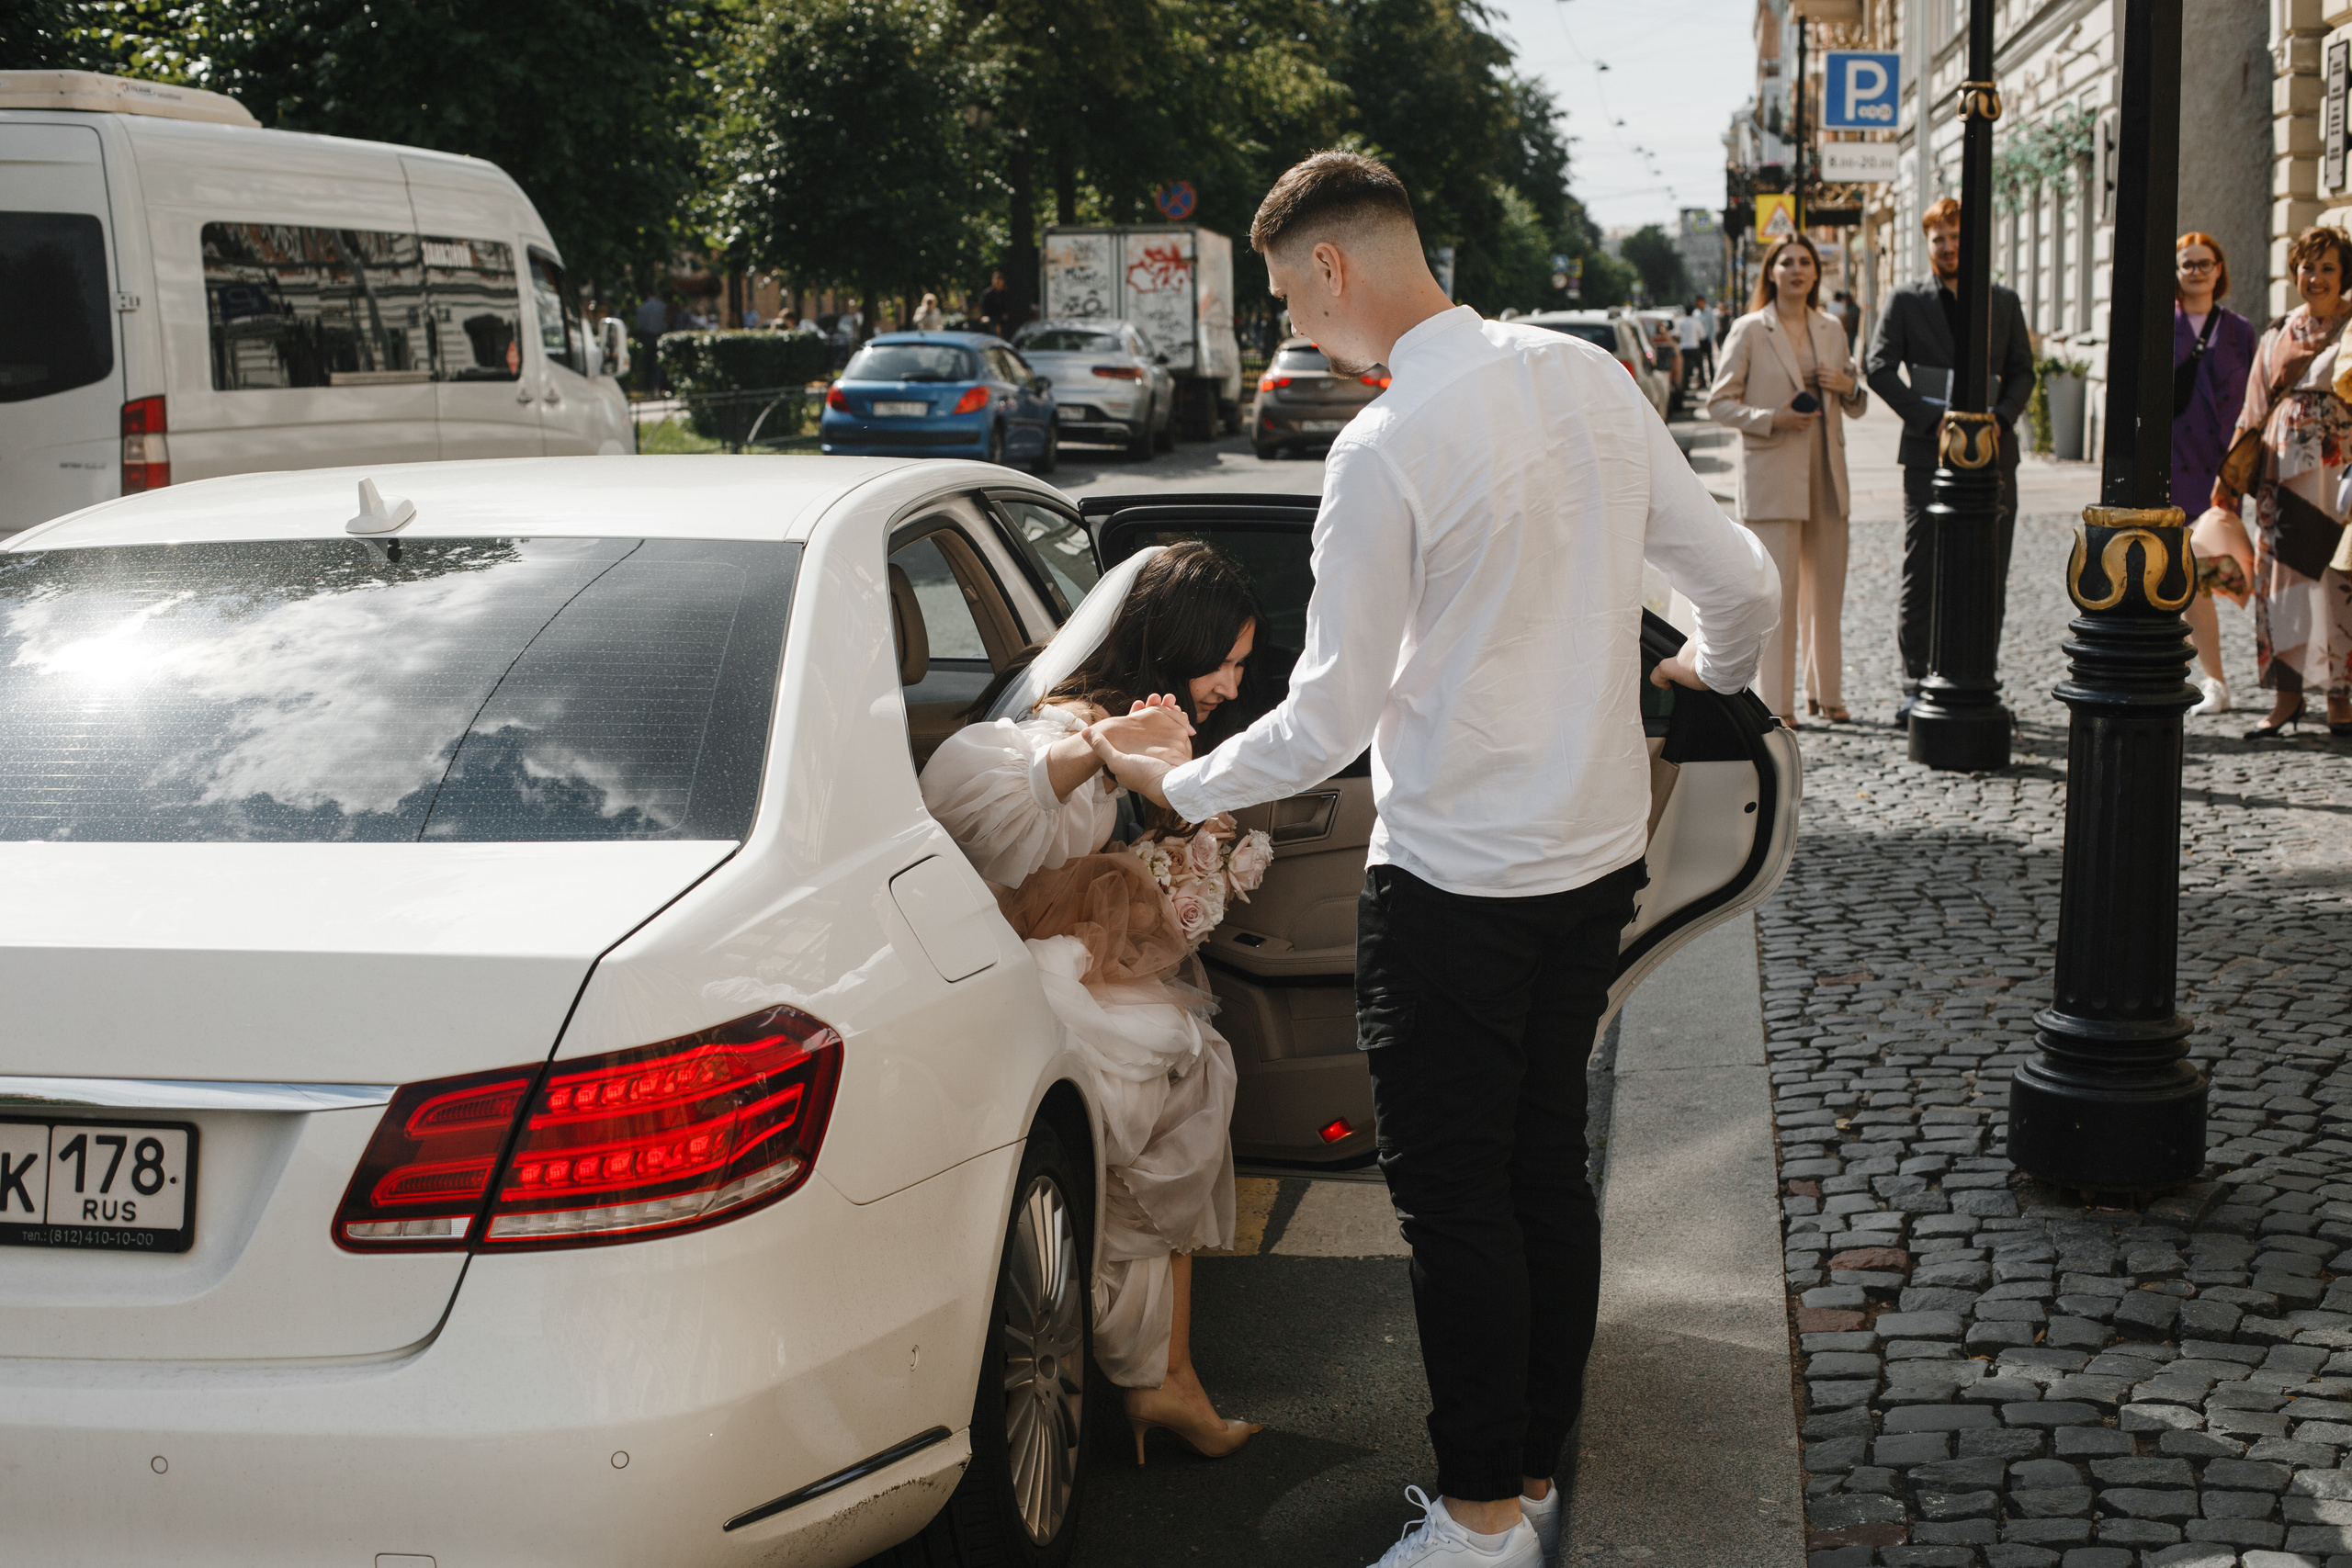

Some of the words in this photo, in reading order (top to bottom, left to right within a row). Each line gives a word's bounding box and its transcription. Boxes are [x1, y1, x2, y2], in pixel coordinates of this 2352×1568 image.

[1845, 60, 1888, 121] P
[58, 1134, 165, 1196] 178
[82, 1199, 137, 1223] RUS
